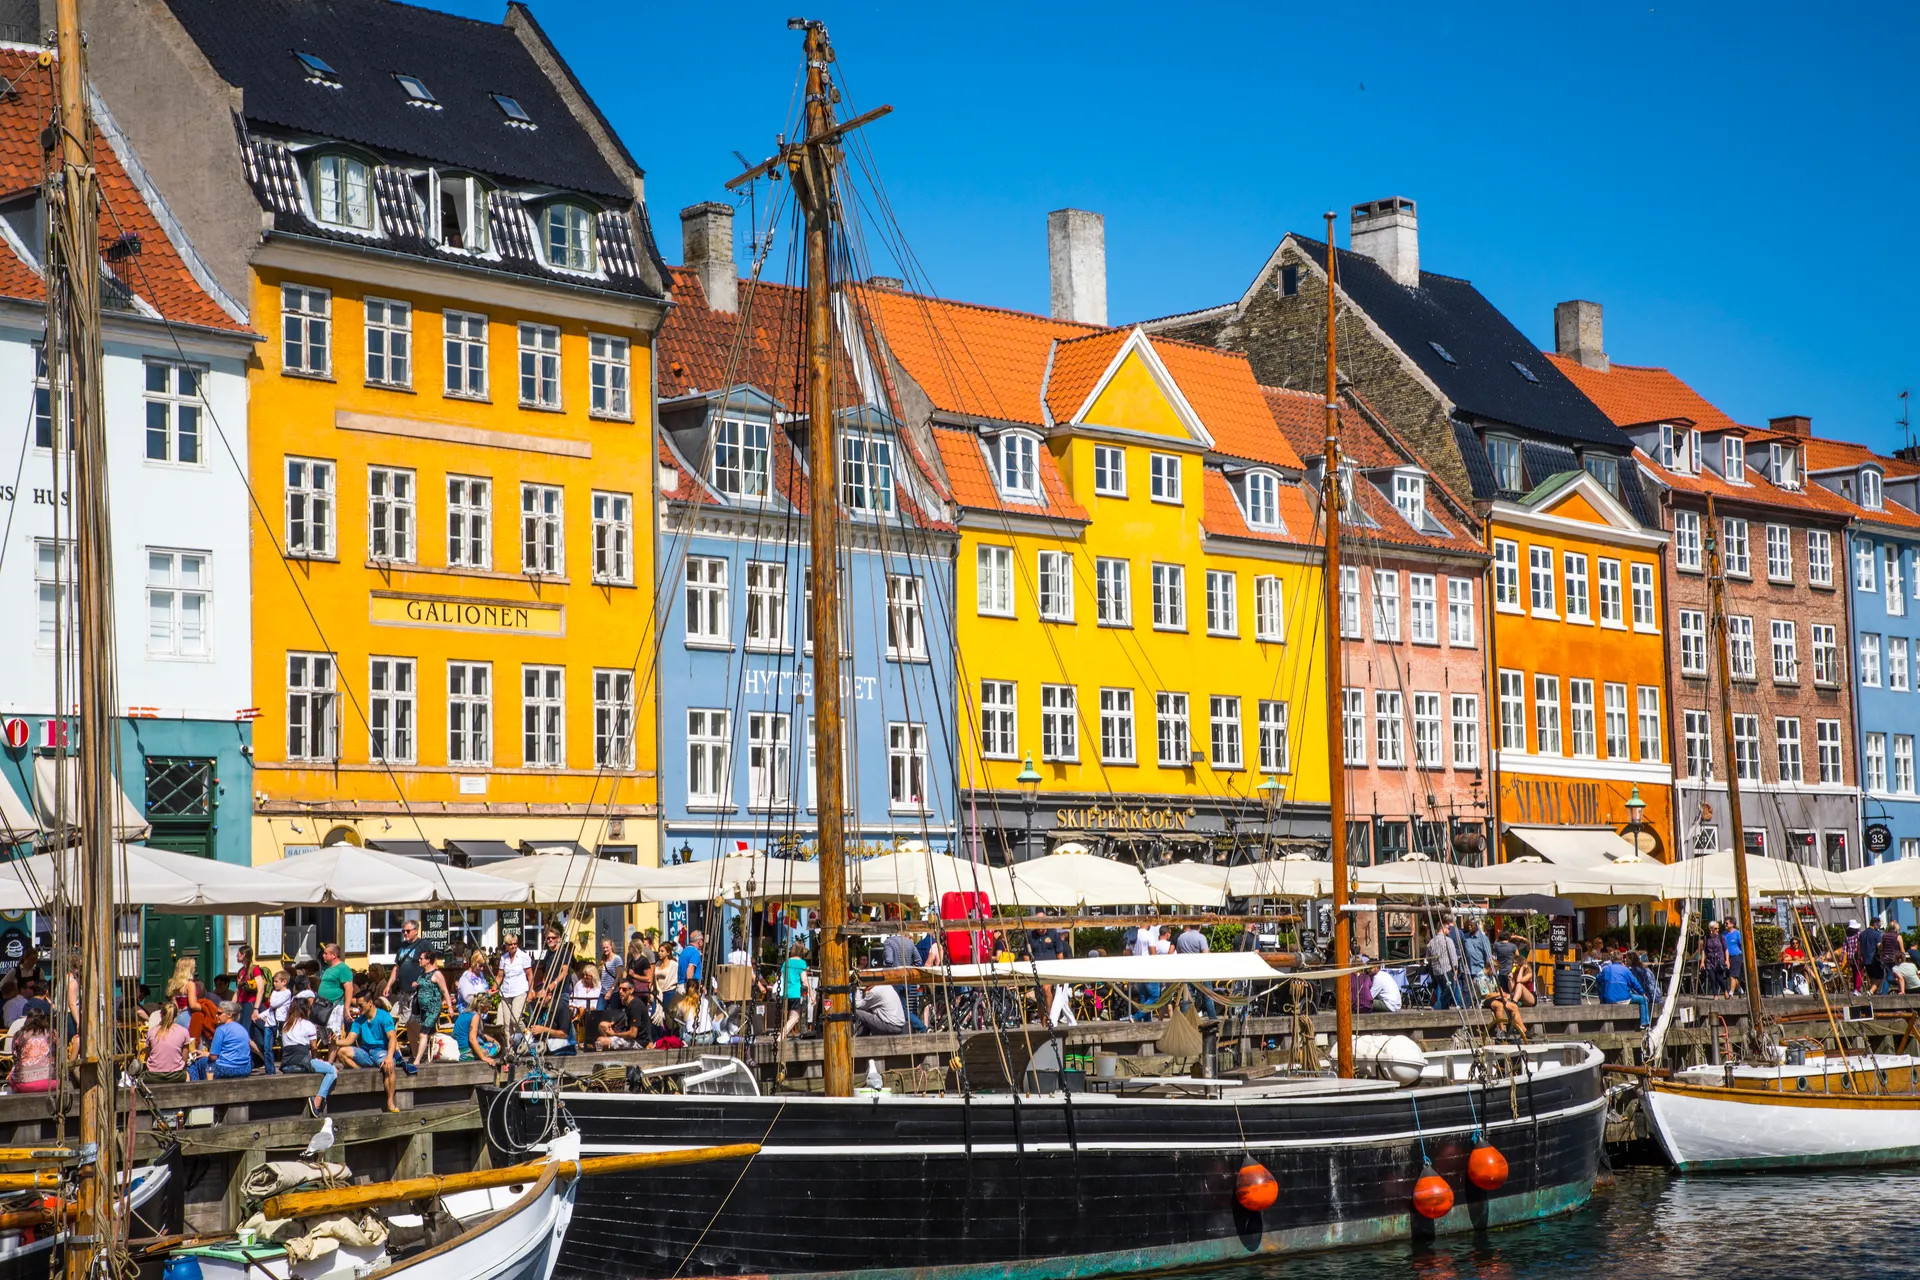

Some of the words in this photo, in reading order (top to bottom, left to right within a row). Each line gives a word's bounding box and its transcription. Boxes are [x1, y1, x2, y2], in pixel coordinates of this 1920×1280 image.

[407, 601, 528, 628] GALIONEN
[1567, 783, 1602, 825] SIDE
[1056, 808, 1187, 829] SKIPPERKROEN
[1872, 835, 1884, 843] 33
[669, 911, 686, 921] LIVE
